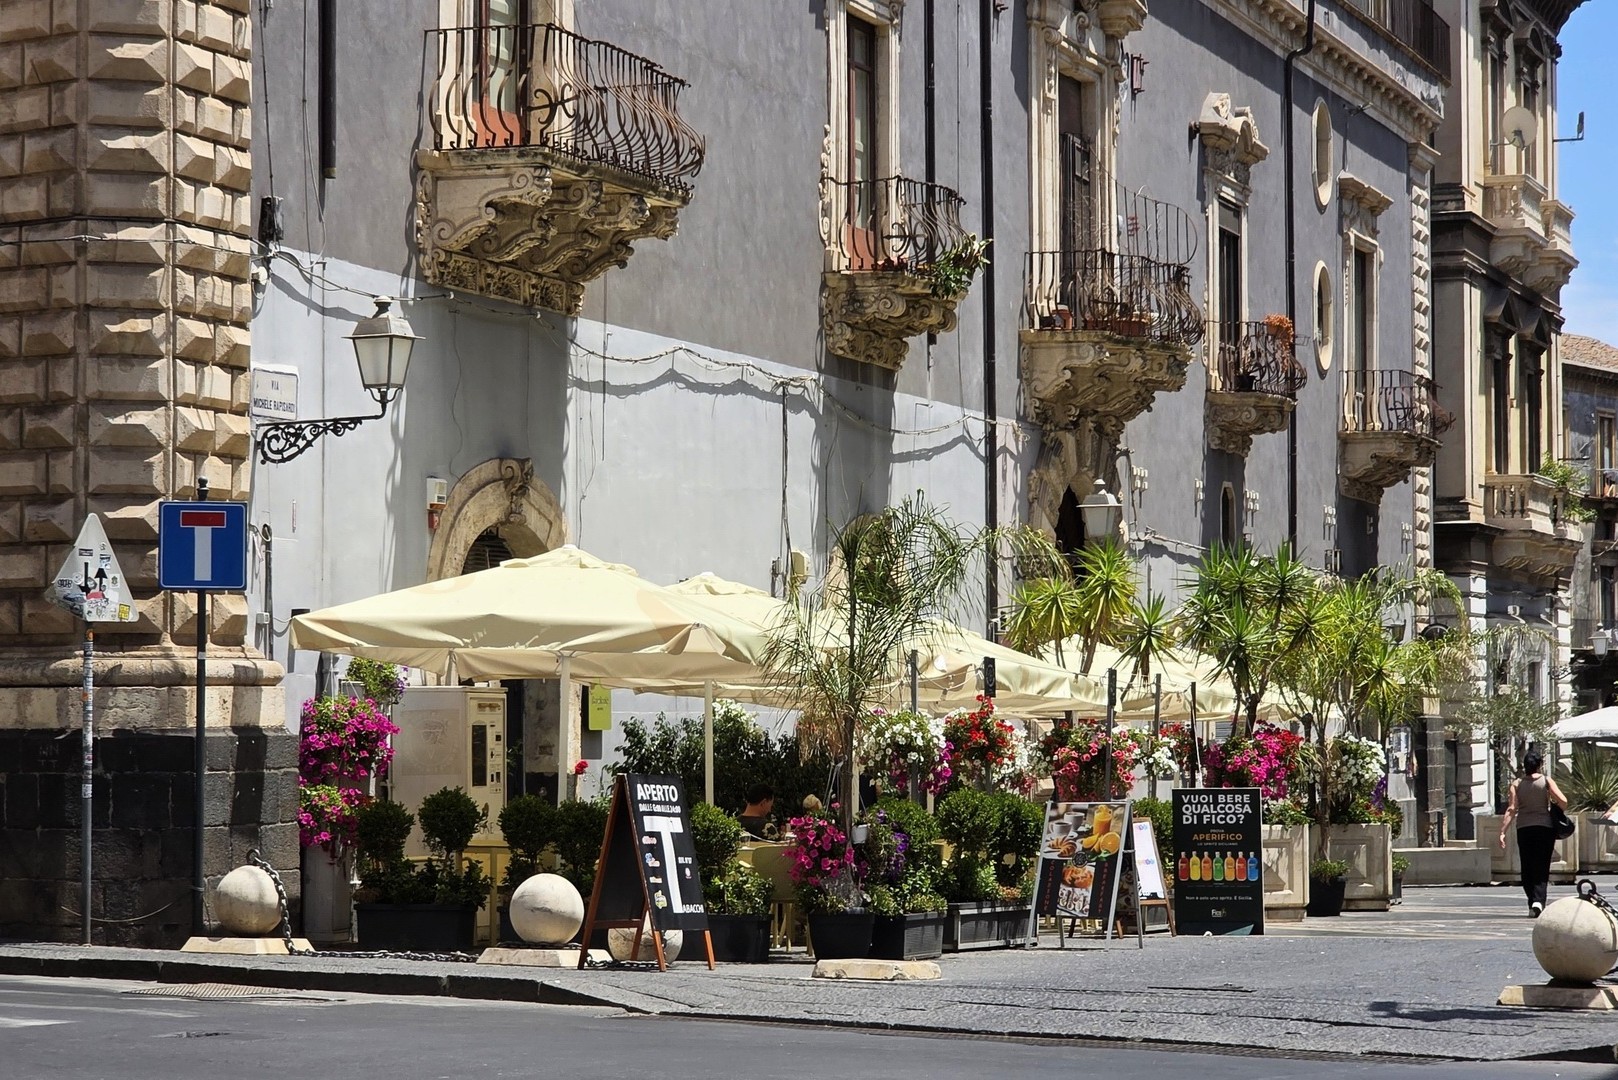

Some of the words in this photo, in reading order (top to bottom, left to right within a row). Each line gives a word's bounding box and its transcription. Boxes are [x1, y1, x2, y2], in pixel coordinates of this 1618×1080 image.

[271, 380, 279, 390] VIA
[254, 398, 272, 410] MICHELE
[637, 784, 678, 802] APERTO
[1181, 794, 1213, 803] VUOI
[1218, 794, 1251, 803] BERE
[1182, 804, 1252, 815] QUALCOSA
[1182, 814, 1197, 825] DI
[1203, 814, 1245, 825] FICO?
[1192, 833, 1243, 841] APERIFICO
